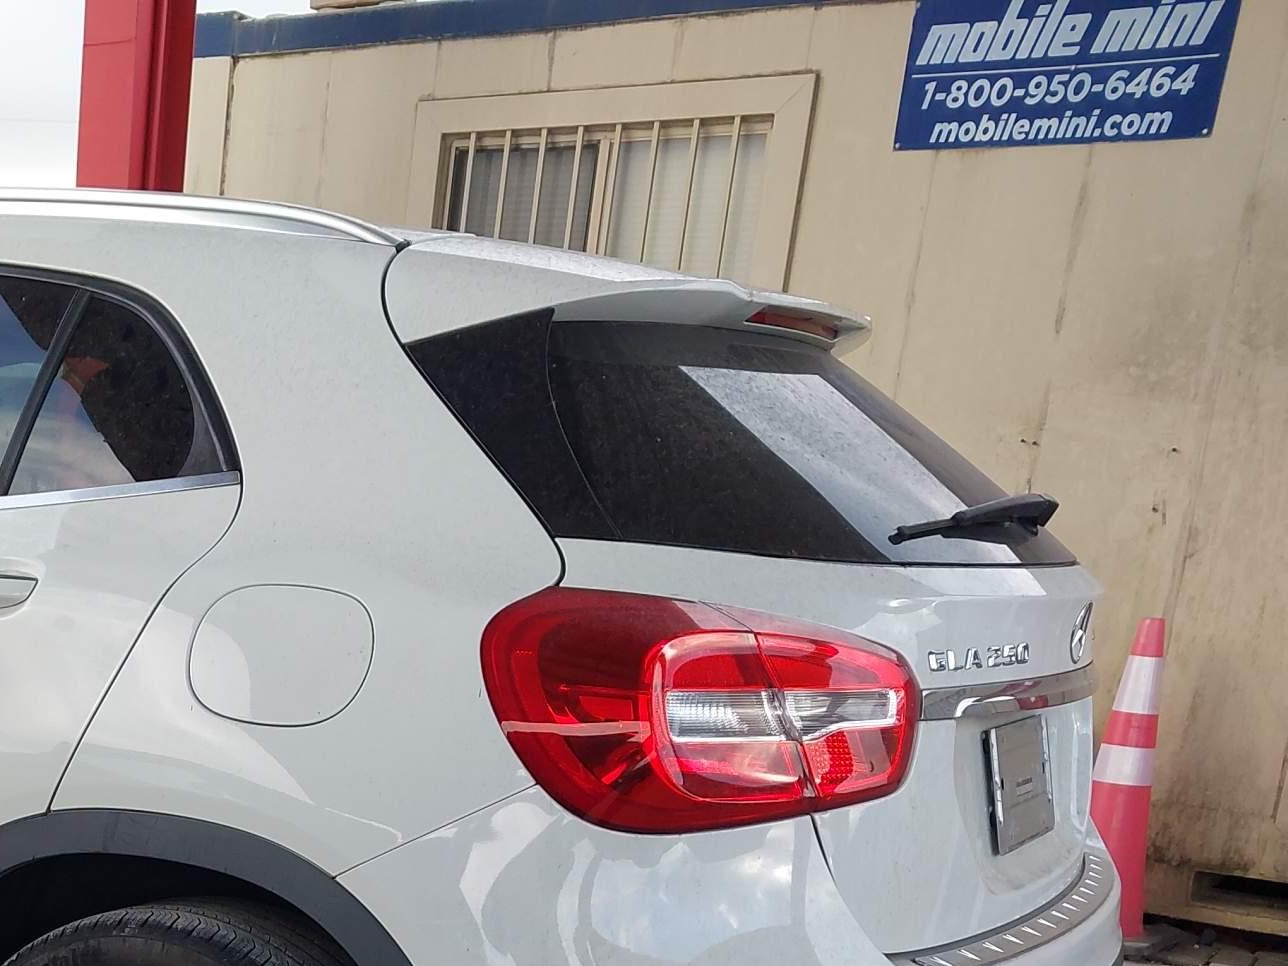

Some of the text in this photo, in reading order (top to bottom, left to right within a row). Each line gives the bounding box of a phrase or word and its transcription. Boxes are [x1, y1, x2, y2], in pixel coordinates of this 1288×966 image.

[915, 0, 1225, 65] mobile mini
[920, 63, 1201, 111] 1-800-950-6464
[928, 108, 1174, 144] mobilemini.com
[927, 641, 1030, 673] GLA 250
